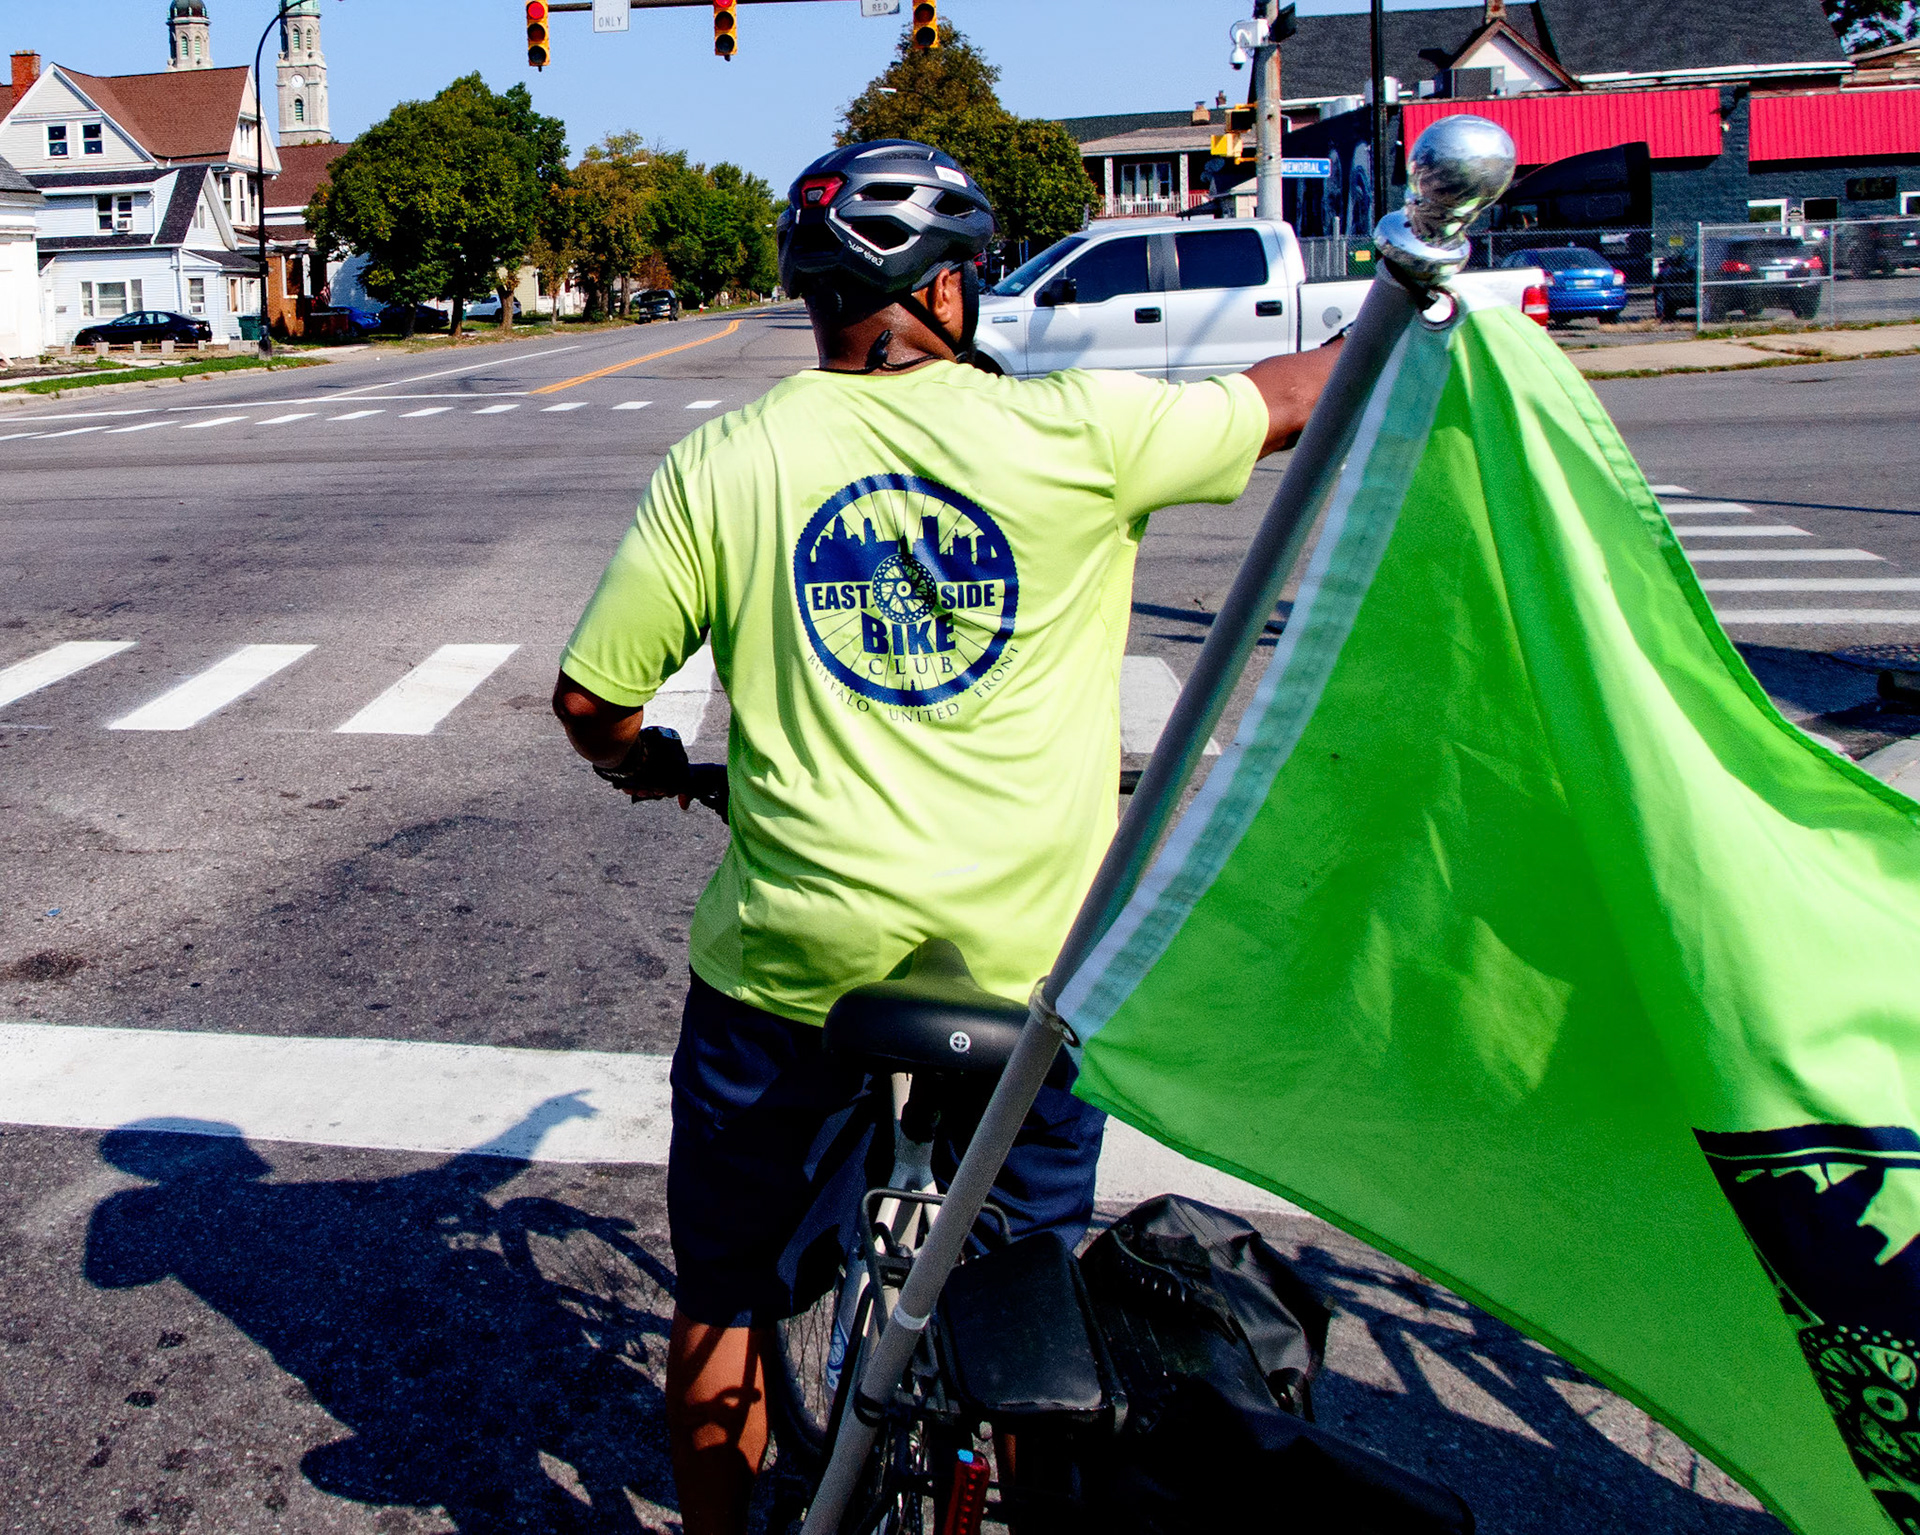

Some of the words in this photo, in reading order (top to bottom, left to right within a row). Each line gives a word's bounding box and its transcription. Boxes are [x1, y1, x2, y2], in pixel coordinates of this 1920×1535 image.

[872, 2, 889, 12] RED
[598, 16, 623, 28] ONLY
[1281, 161, 1321, 174] MEMORIAL
[811, 584, 870, 610] EAST
[940, 584, 996, 608] SIDE
[861, 611, 956, 655] BIKE
[868, 656, 954, 676] CLUB
[807, 654, 870, 712] BUFFALO
[888, 702, 960, 723] UNITED
[974, 643, 1020, 698] FRONT
